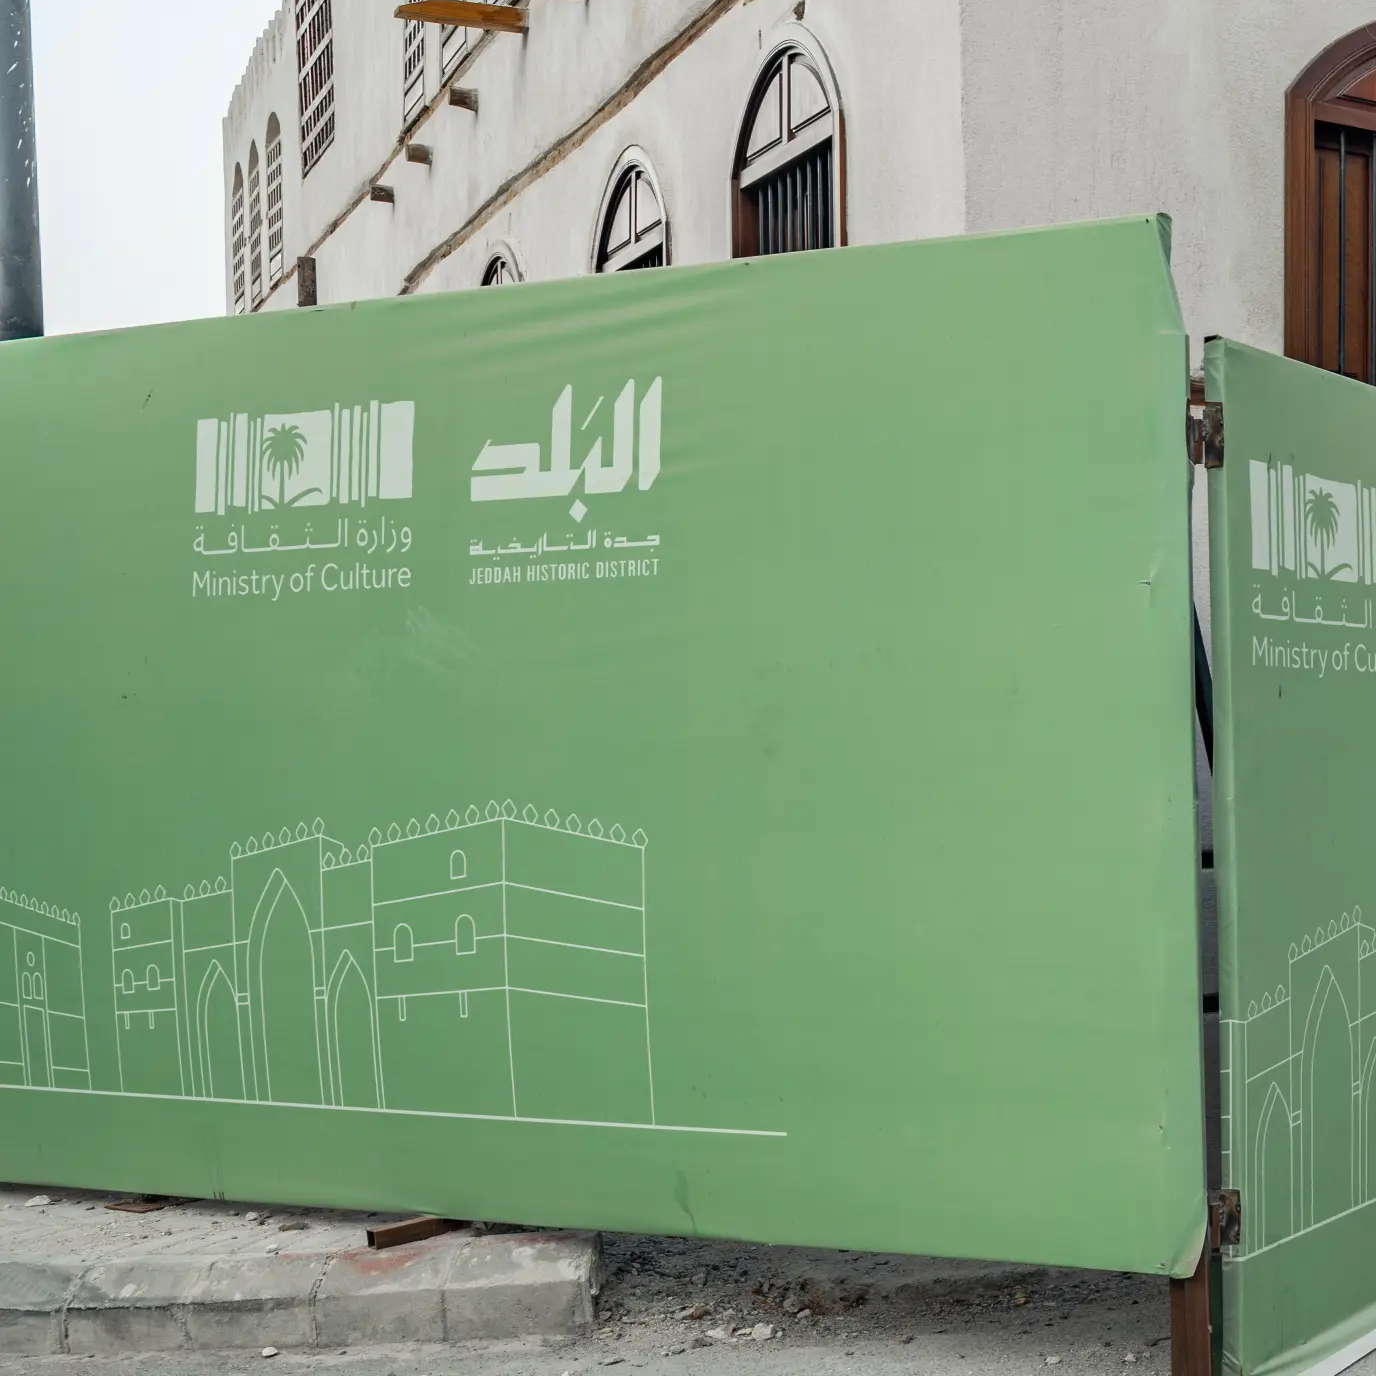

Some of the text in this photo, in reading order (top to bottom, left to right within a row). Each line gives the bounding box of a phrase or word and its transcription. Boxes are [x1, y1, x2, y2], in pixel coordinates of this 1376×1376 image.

[193, 516, 412, 556] وزارة الثقافة
[469, 529, 660, 561] جدة التاريخية
[192, 561, 412, 602] Ministry of Culture
[469, 558, 661, 585] JEDDAH HISTORIC DISTRICT
[1251, 583, 1373, 629] الثقافة
[1252, 635, 1328, 679] Ministry
[1331, 643, 1351, 671] of
